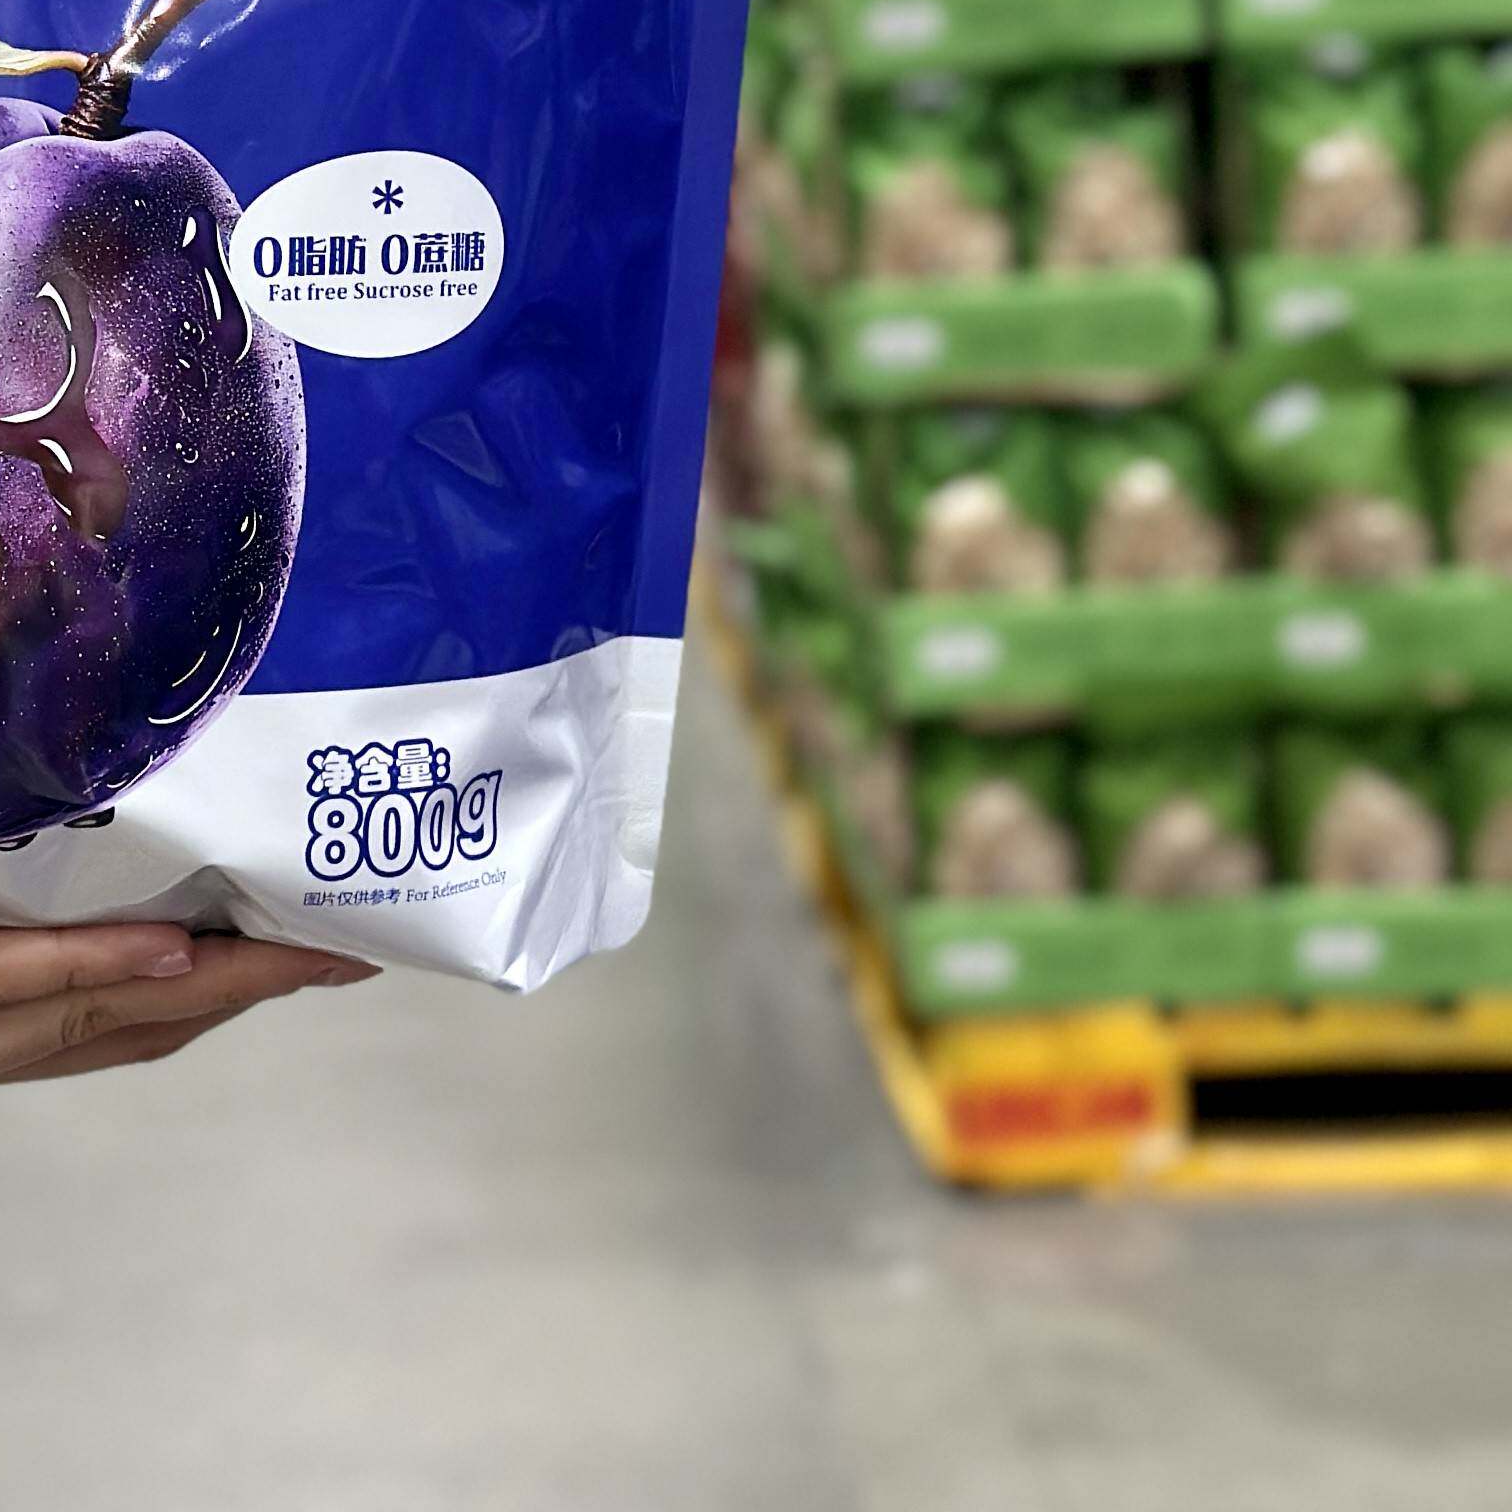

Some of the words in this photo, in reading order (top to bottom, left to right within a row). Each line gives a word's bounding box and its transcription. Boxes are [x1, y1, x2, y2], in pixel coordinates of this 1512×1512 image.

[253, 235, 367, 278] 0脂肪
[381, 231, 485, 276] 0蔗糖
[268, 283, 302, 302] Fat
[307, 282, 347, 301] free
[353, 281, 434, 300] Sucrose
[439, 279, 478, 297] free
[307, 738, 451, 798] 净含量:
[305, 769, 503, 882] 800g
[303, 889, 401, 906] 图片仅供参考
[406, 889, 429, 903] For
[432, 876, 480, 900] Reference
[480, 867, 507, 886] Only
